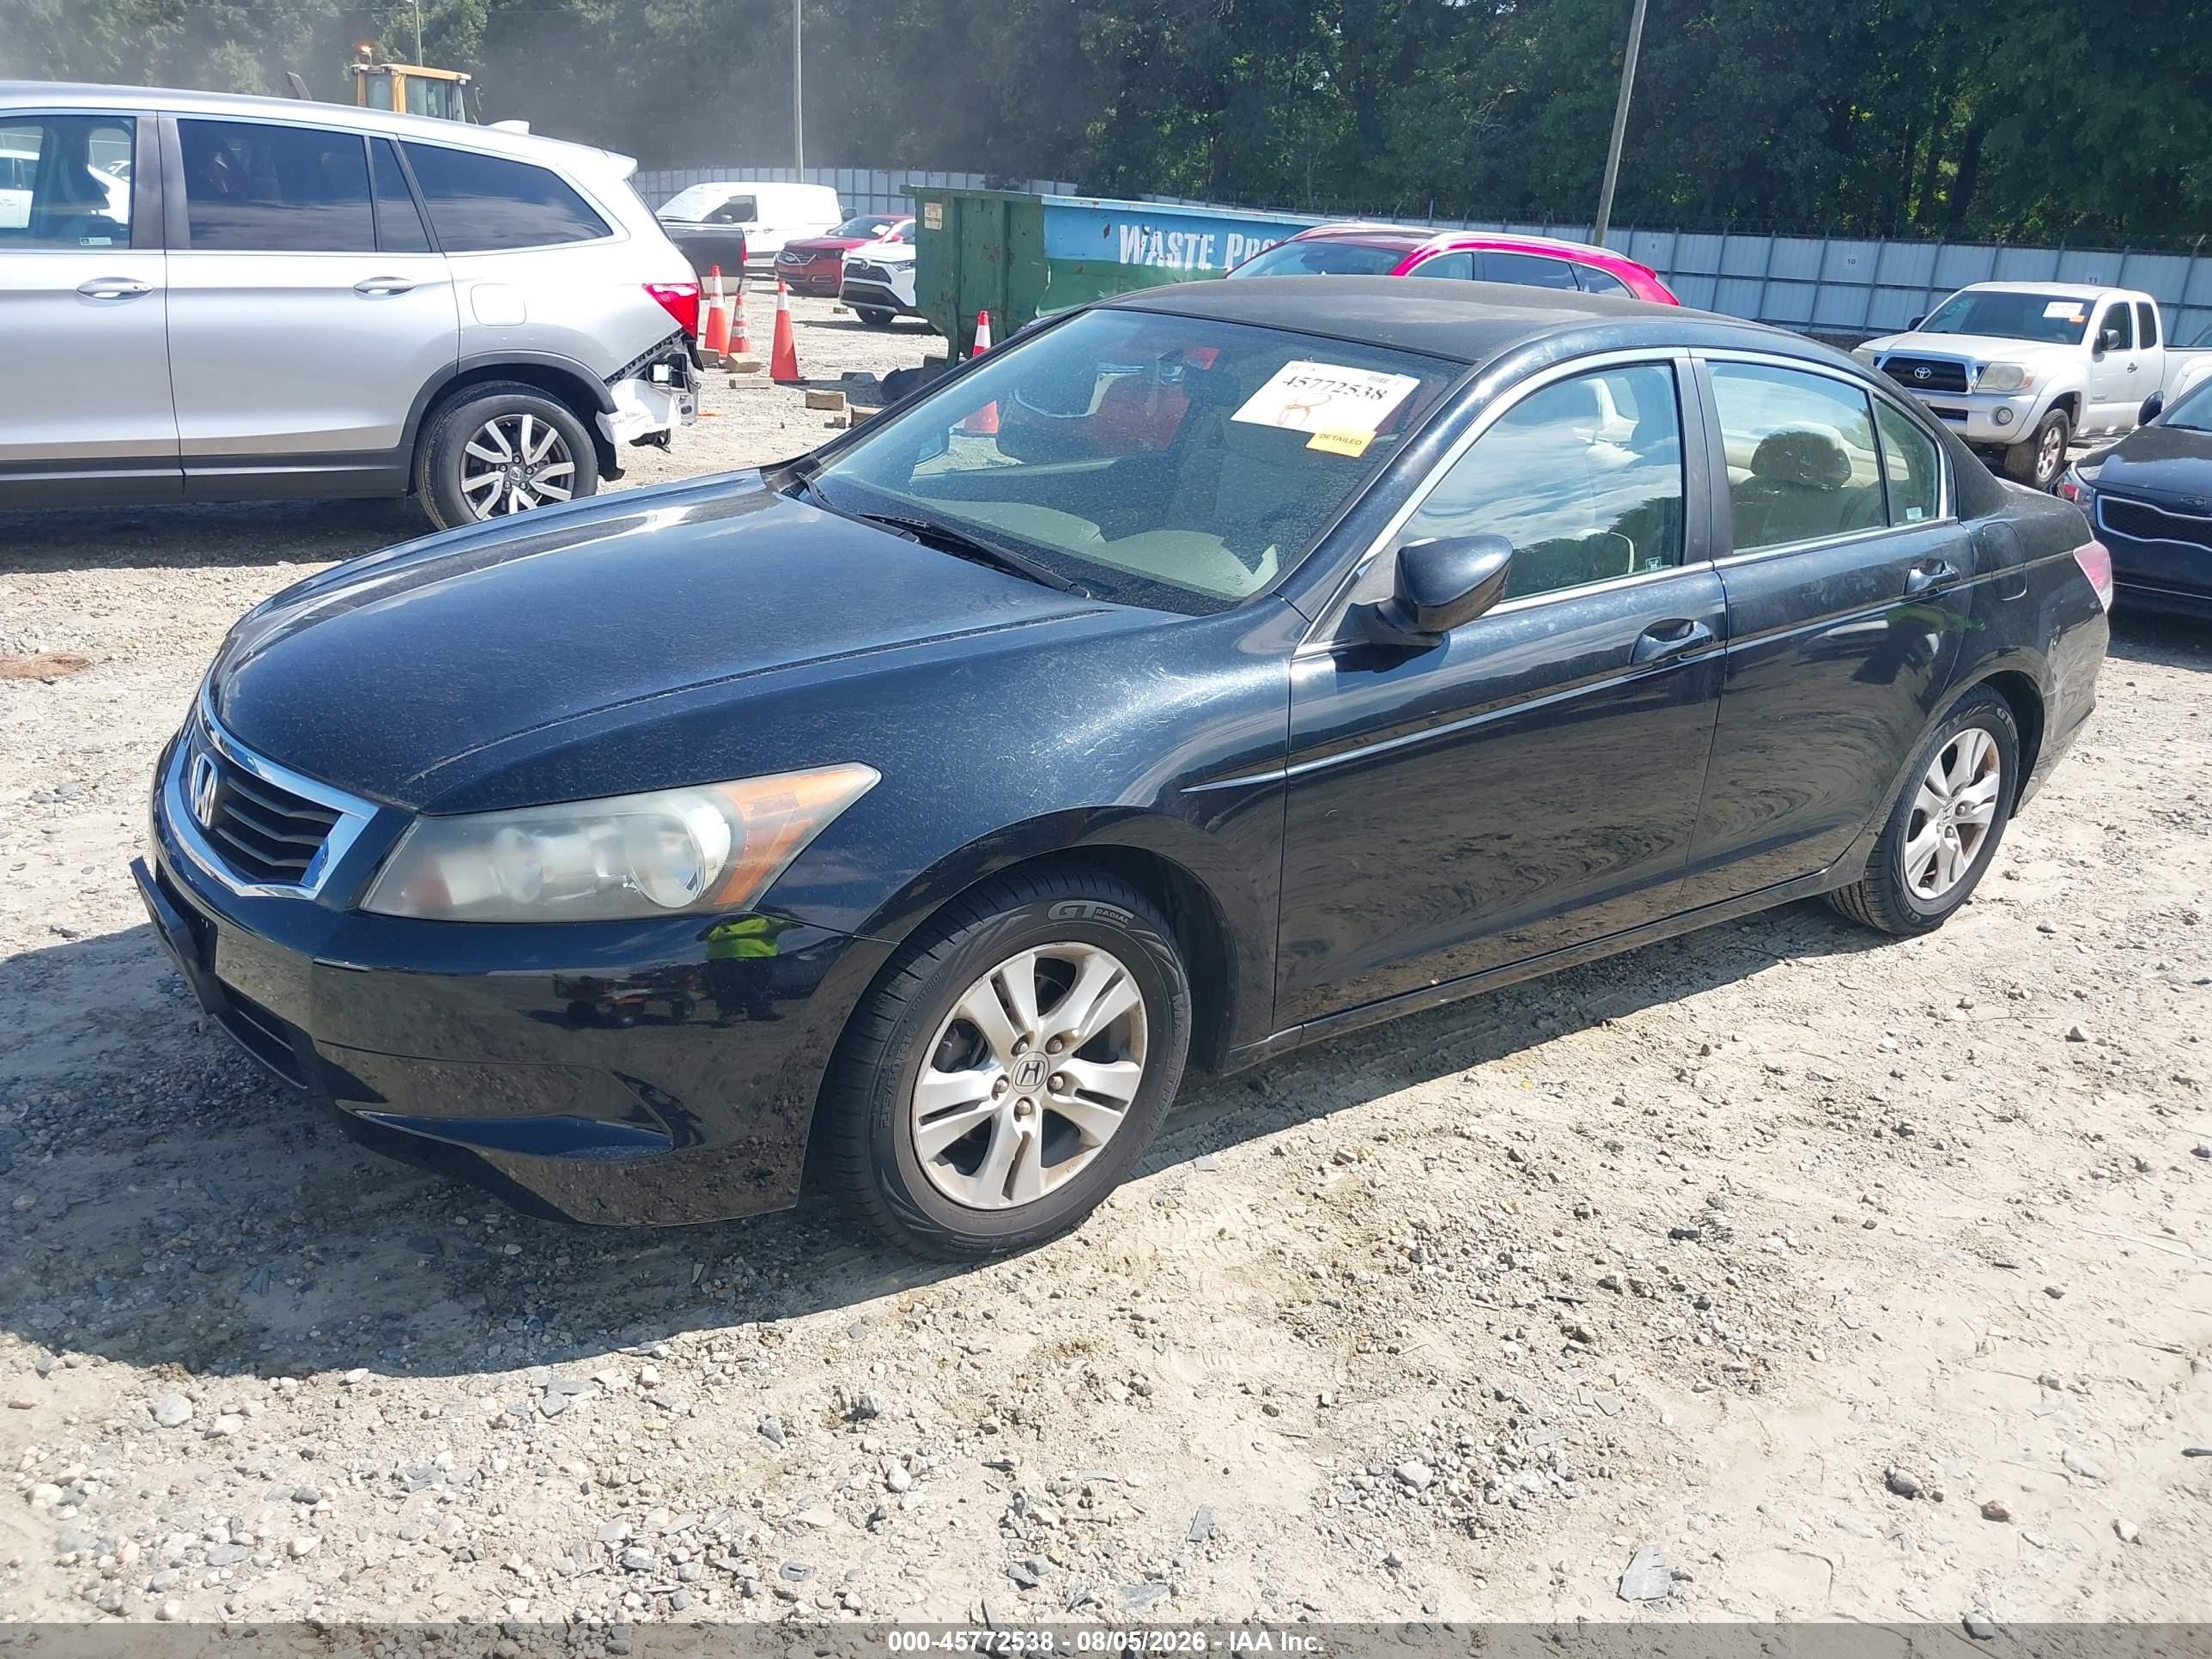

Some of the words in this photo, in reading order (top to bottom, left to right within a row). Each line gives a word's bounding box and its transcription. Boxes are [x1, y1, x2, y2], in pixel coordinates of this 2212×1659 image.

[1119, 224, 1216, 270] WASTE
[1283, 375, 1388, 400] 45772538
[1319, 433, 1363, 447] DETAILED
[1048, 900, 1115, 921] GT
[1096, 908, 1129, 925] RADIAL
